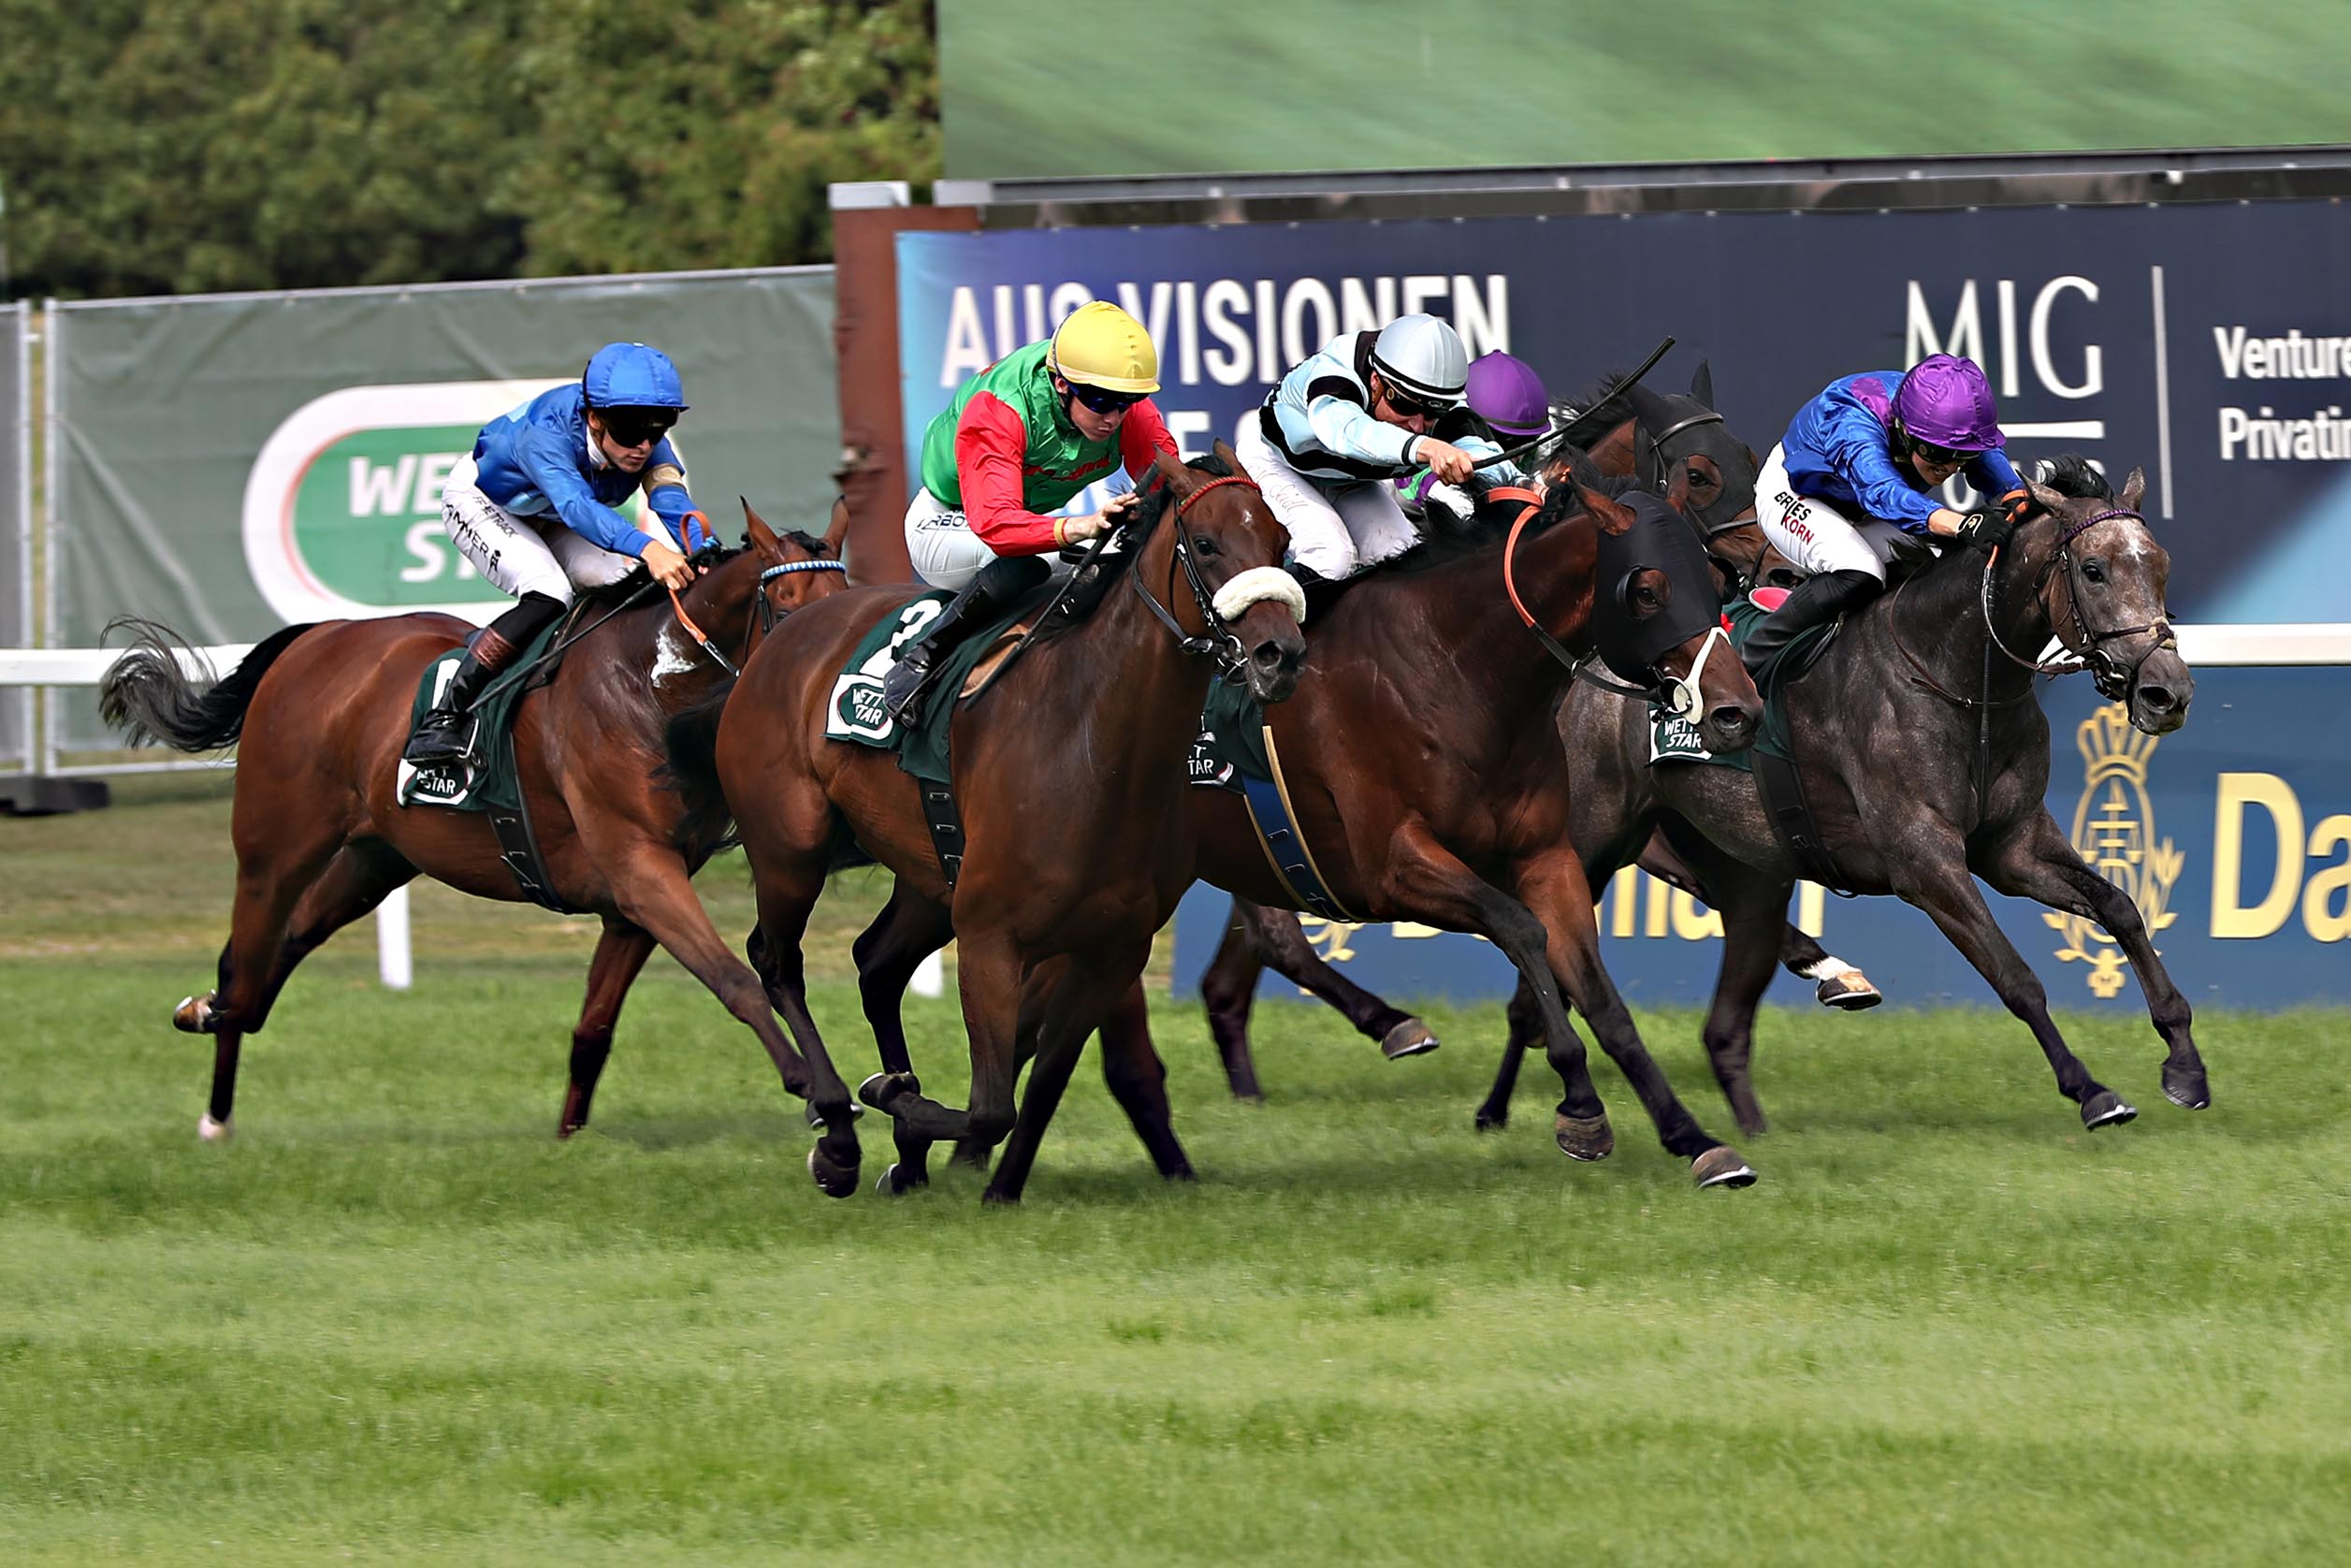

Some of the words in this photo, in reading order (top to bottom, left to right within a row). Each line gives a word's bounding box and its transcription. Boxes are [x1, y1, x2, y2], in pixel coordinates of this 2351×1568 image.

[1905, 275, 2103, 399] MIG
[349, 453, 458, 516] WE
[1782, 515, 1815, 545] KORN
[1665, 733, 1702, 748] STAR
[1186, 759, 1214, 776] TAR
